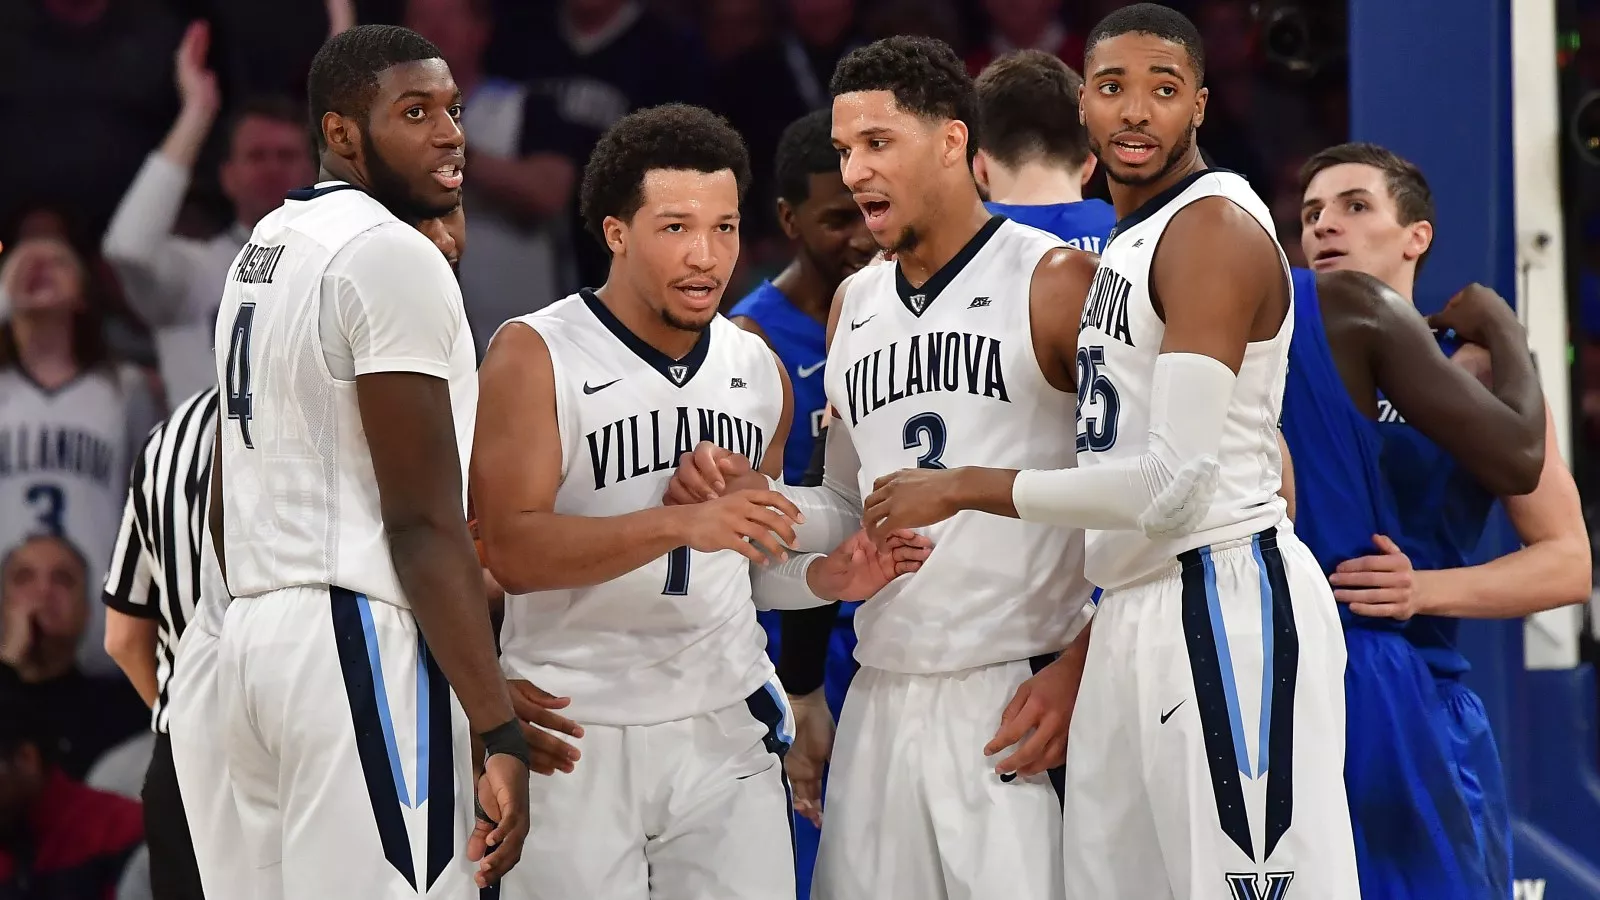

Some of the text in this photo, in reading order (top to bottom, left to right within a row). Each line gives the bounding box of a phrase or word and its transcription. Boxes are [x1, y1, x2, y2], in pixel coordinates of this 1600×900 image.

[226, 302, 257, 450] 4
[845, 330, 1012, 428] VILLANOVA
[1076, 345, 1121, 453] 25
[902, 411, 948, 470] 3
